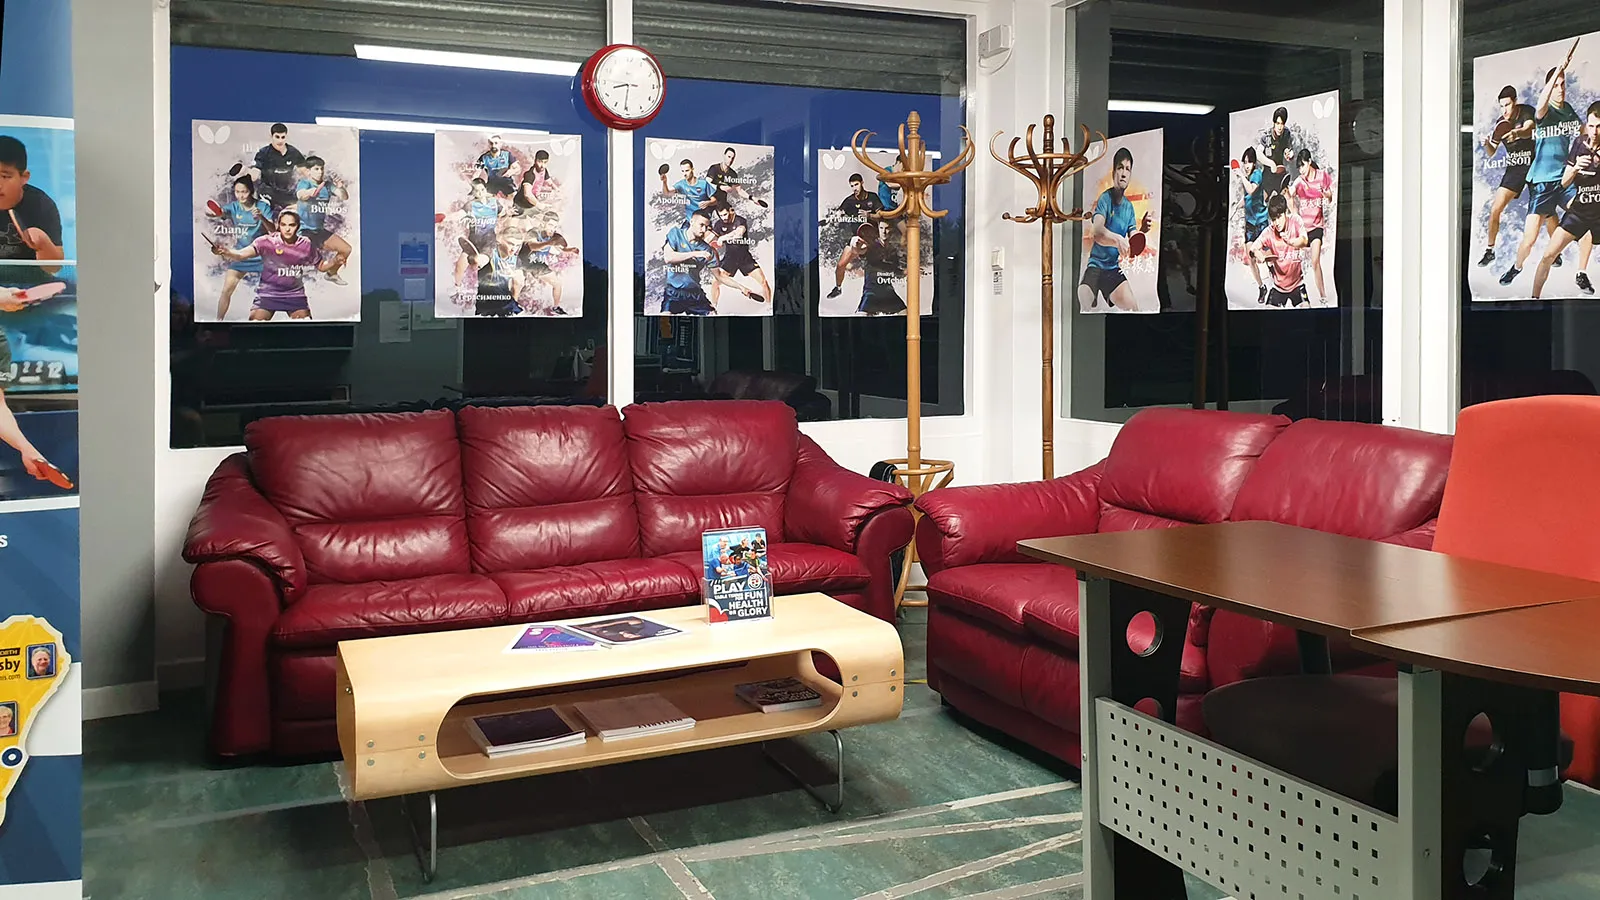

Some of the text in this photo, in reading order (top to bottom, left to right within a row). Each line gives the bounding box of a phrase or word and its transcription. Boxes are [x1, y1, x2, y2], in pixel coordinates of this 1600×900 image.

[1558, 120, 1580, 129] Anton
[1531, 124, 1582, 140] Källberg
[1506, 150, 1532, 159] Kristian
[1483, 155, 1531, 169] Karlsson
[723, 175, 757, 184] Monteiro
[214, 225, 248, 236] Zhang
[726, 237, 756, 246] Geraldo
[662, 265, 690, 274] Freitas
[713, 582, 746, 595] PLAY
[745, 591, 763, 600] FUN
[728, 599, 764, 610] HEALTH
[738, 607, 768, 617] GLORY
